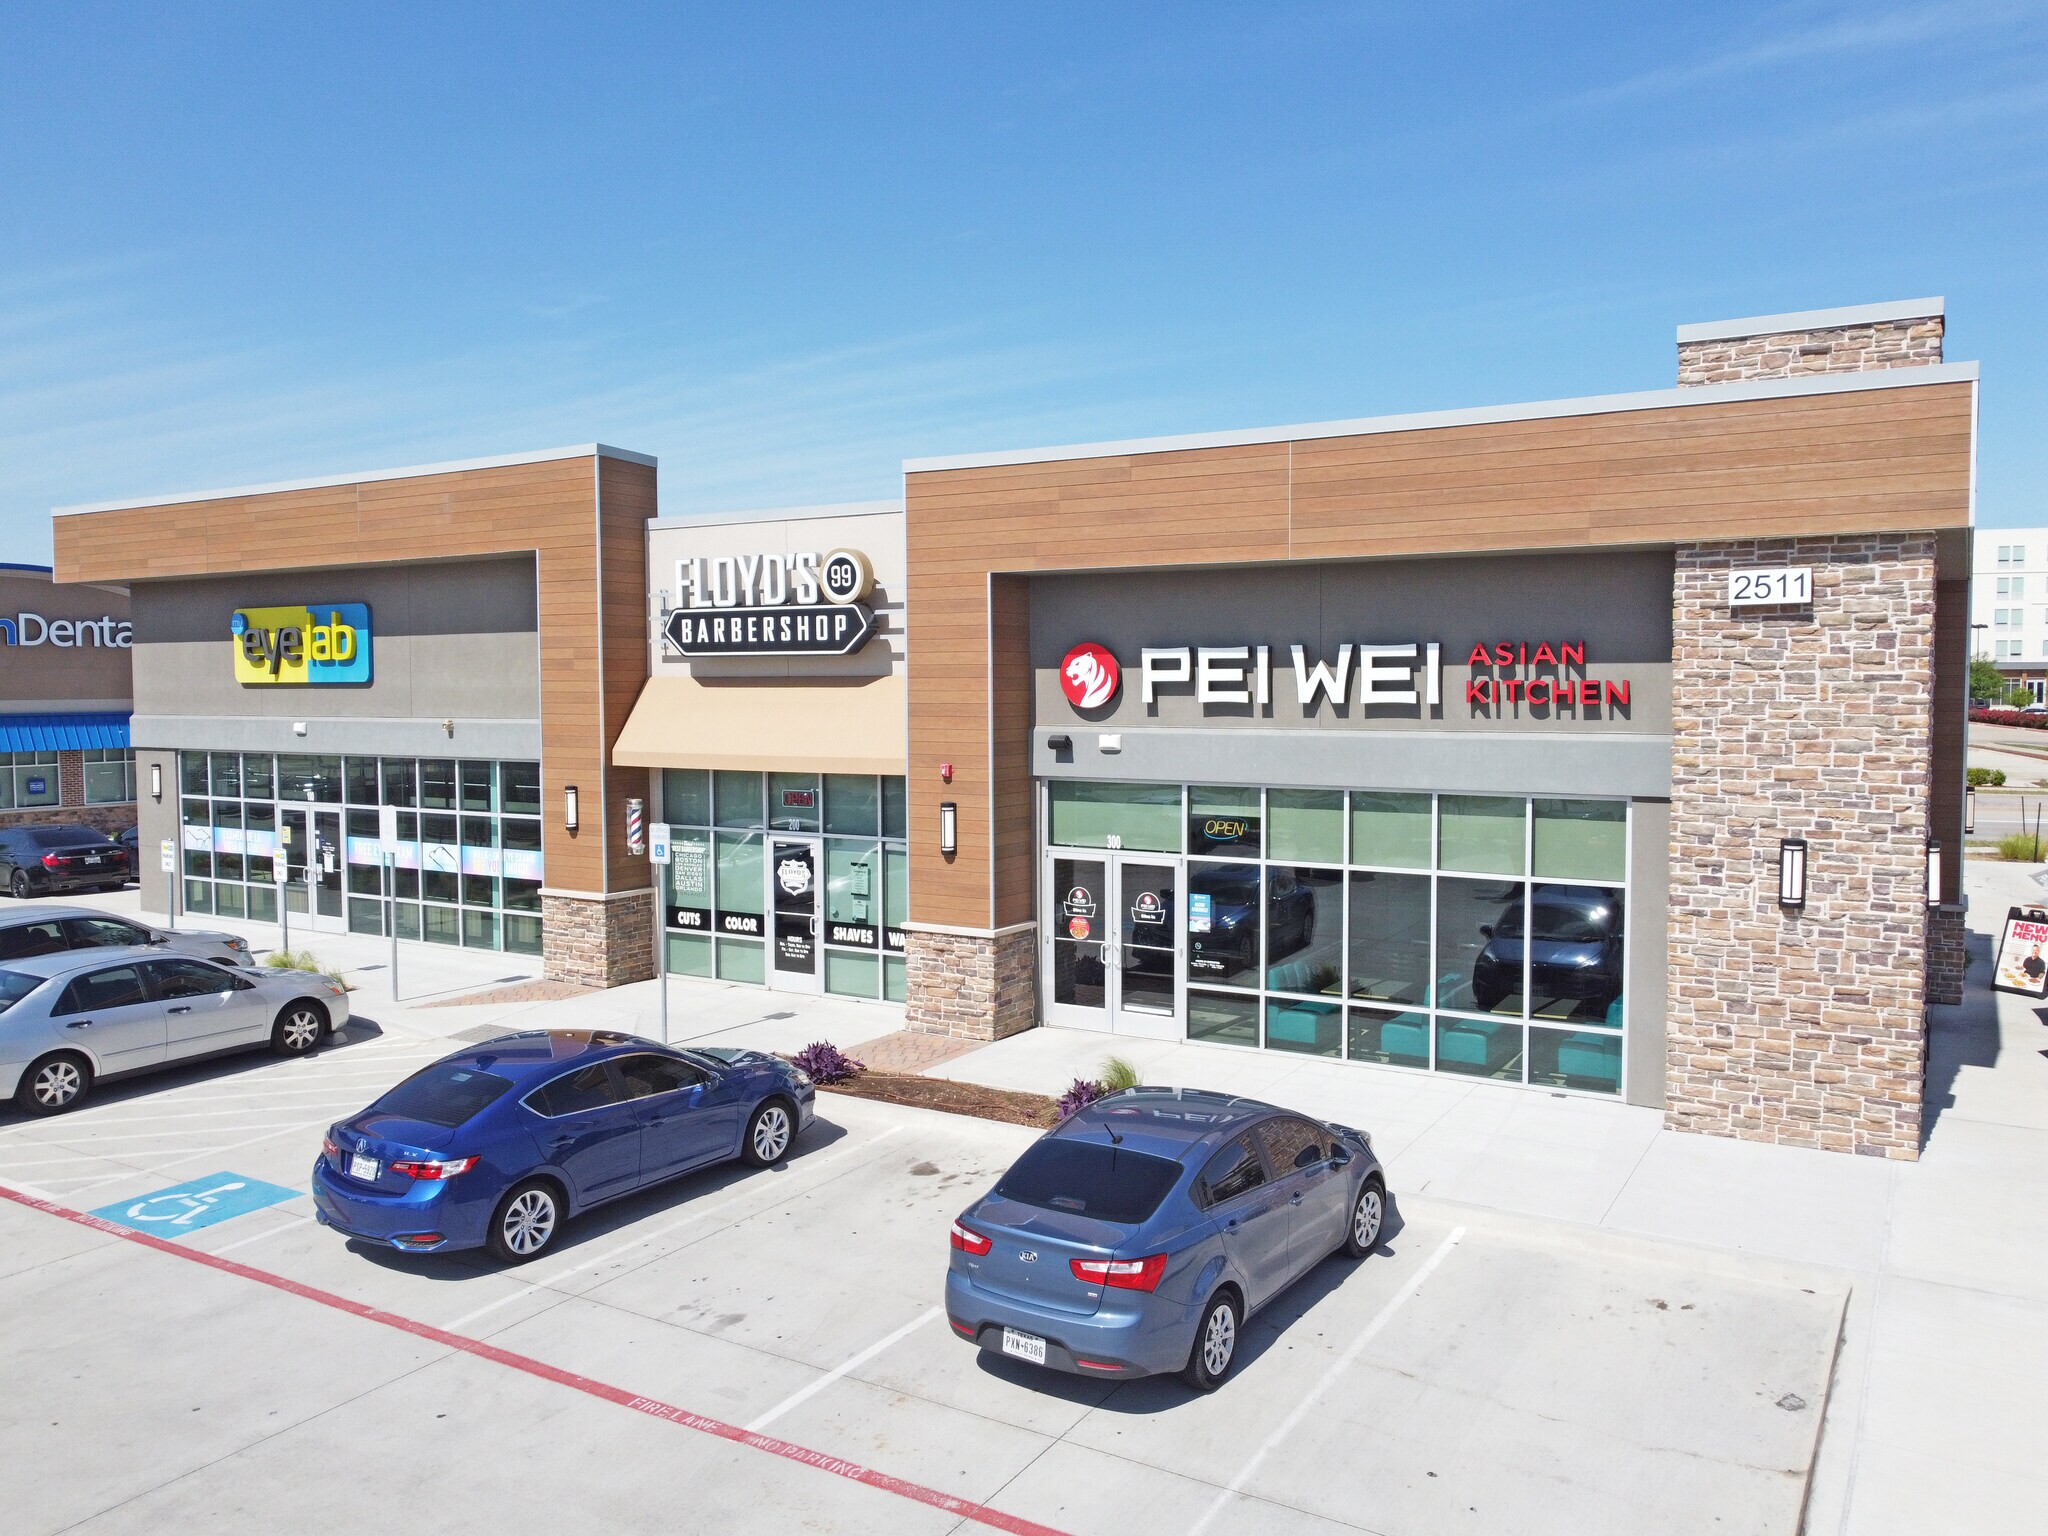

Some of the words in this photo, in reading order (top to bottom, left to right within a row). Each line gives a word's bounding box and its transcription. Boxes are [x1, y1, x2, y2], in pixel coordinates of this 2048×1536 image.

[675, 552, 822, 608] FLOYD'S
[831, 564, 852, 587] 99
[1733, 572, 1805, 600] 2511
[681, 614, 847, 643] BARBERSHOP
[243, 611, 357, 674] eyelab
[1466, 640, 1585, 666] ASIAN
[1141, 646, 1269, 704] PEI
[1290, 642, 1440, 704] WEI
[1465, 679, 1630, 705] KITCHEN
[784, 791, 813, 806] OPEN
[788, 818, 800, 831] 200
[1205, 820, 1245, 836] OPEN
[1106, 834, 1121, 850] 300
[675, 865, 703, 873] DENVER
[677, 910, 701, 927] CUTS
[725, 915, 758, 933] COLOR
[833, 926, 873, 944] SHAVES
[2012, 931, 2048, 943] MENU
[2014, 922, 2048, 934] NEW
[1016, 1331, 1034, 1341] TEXAS
[626, 1397, 673, 1419] FIRE
[669, 1410, 722, 1433] LANE
[752, 1436, 781, 1451] NO
[780, 1445, 864, 1479] PARKING
